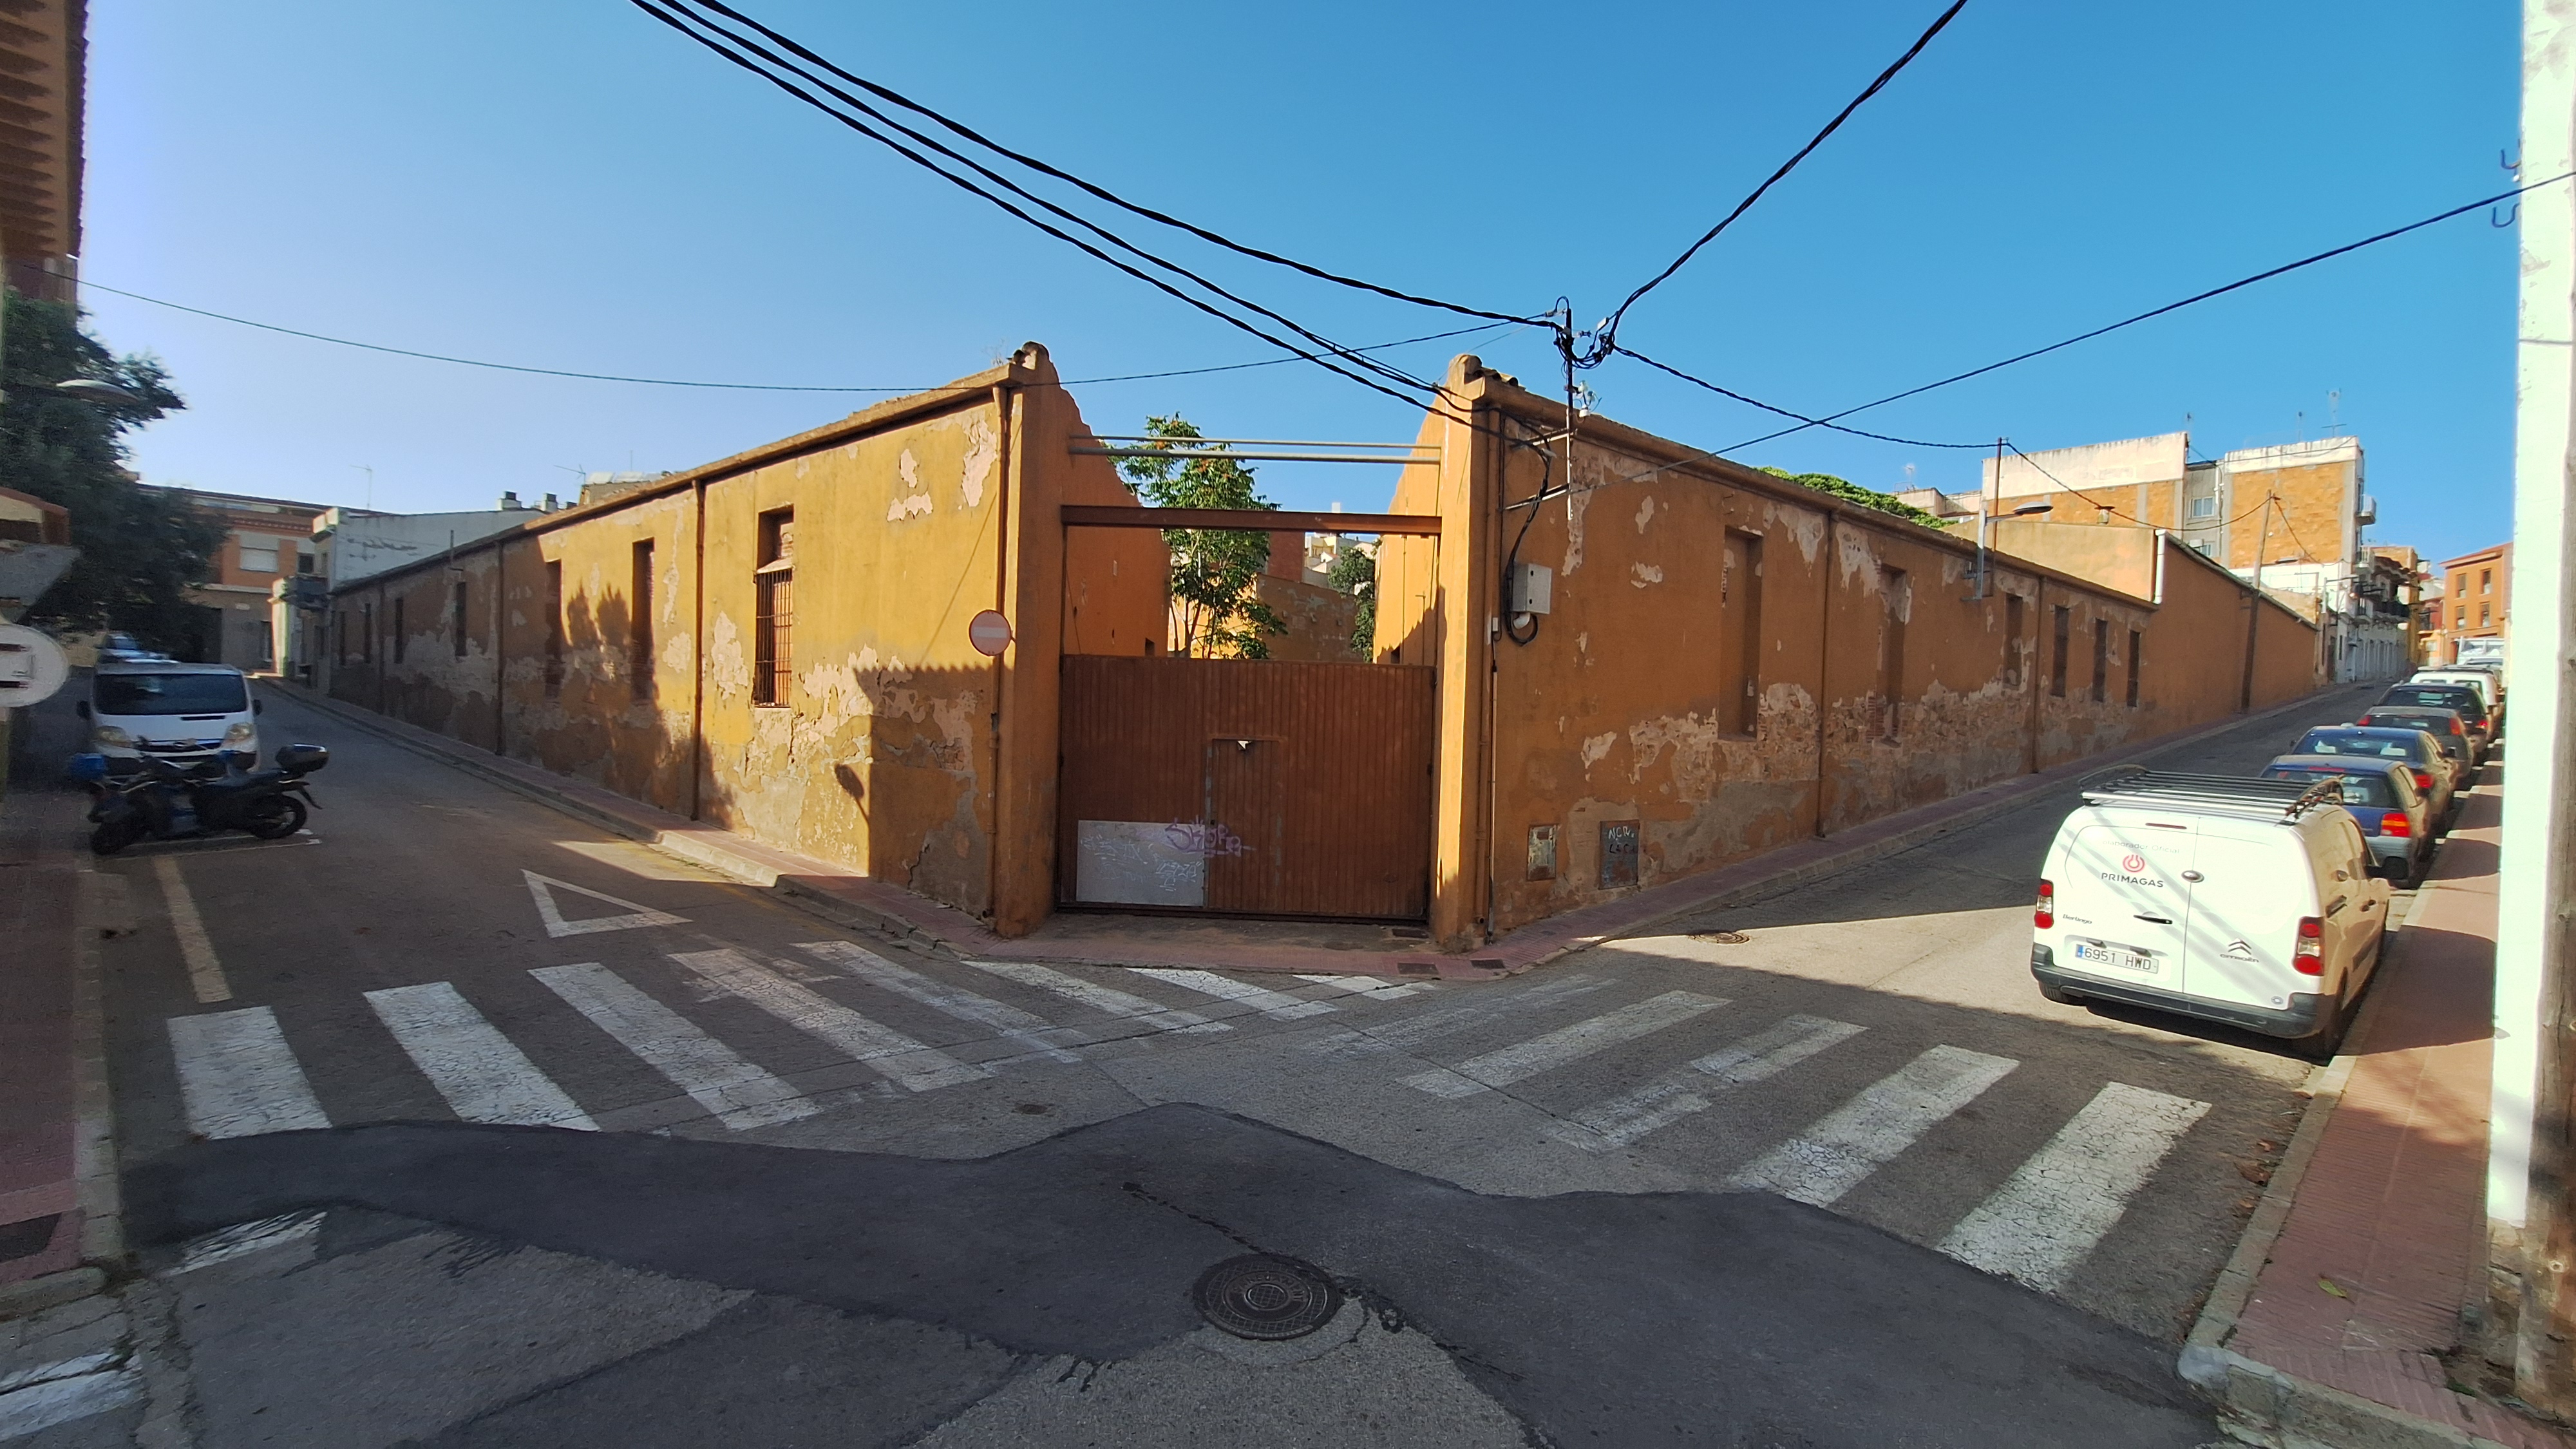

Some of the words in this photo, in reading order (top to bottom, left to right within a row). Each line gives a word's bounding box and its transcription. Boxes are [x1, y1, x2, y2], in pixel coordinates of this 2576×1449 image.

[2152, 845, 2180, 854] Oficial
[2101, 872, 2164, 888] PRIMAGAS
[2063, 913, 2092, 924] Berlingo
[2084, 947, 2116, 963] 6951
[2125, 955, 2152, 970] HWD
